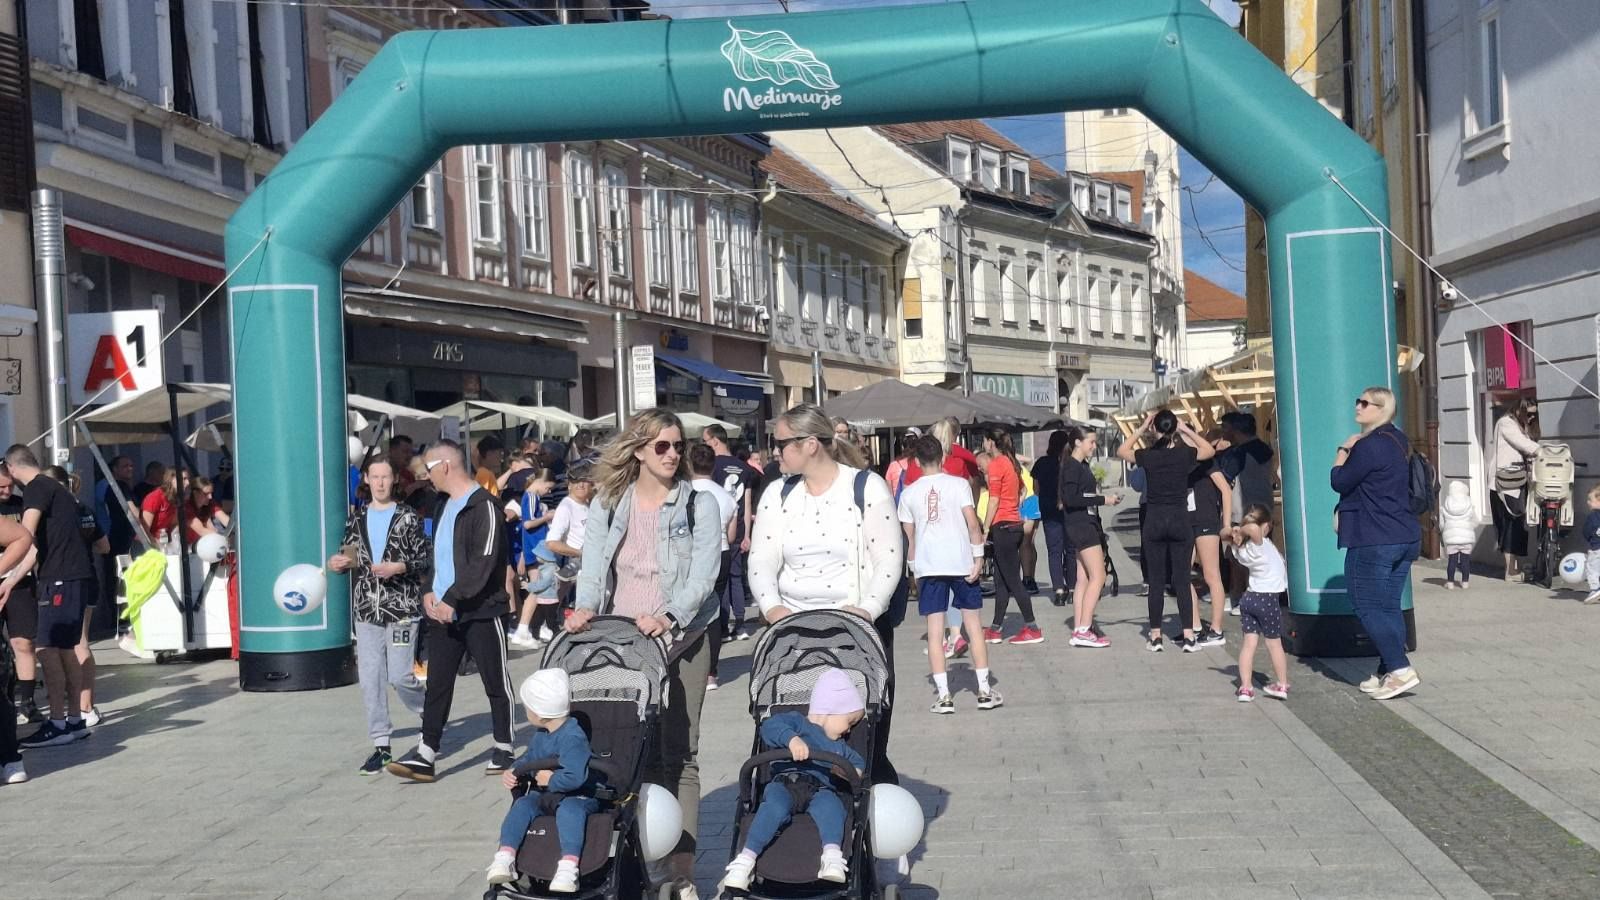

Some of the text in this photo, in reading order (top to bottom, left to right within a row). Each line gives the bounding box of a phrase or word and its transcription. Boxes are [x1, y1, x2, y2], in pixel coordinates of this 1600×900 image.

[723, 86, 842, 112] Međimurje
[84, 325, 147, 392] A1
[973, 375, 1021, 400] MODA
[1487, 367, 1506, 386] BIPA
